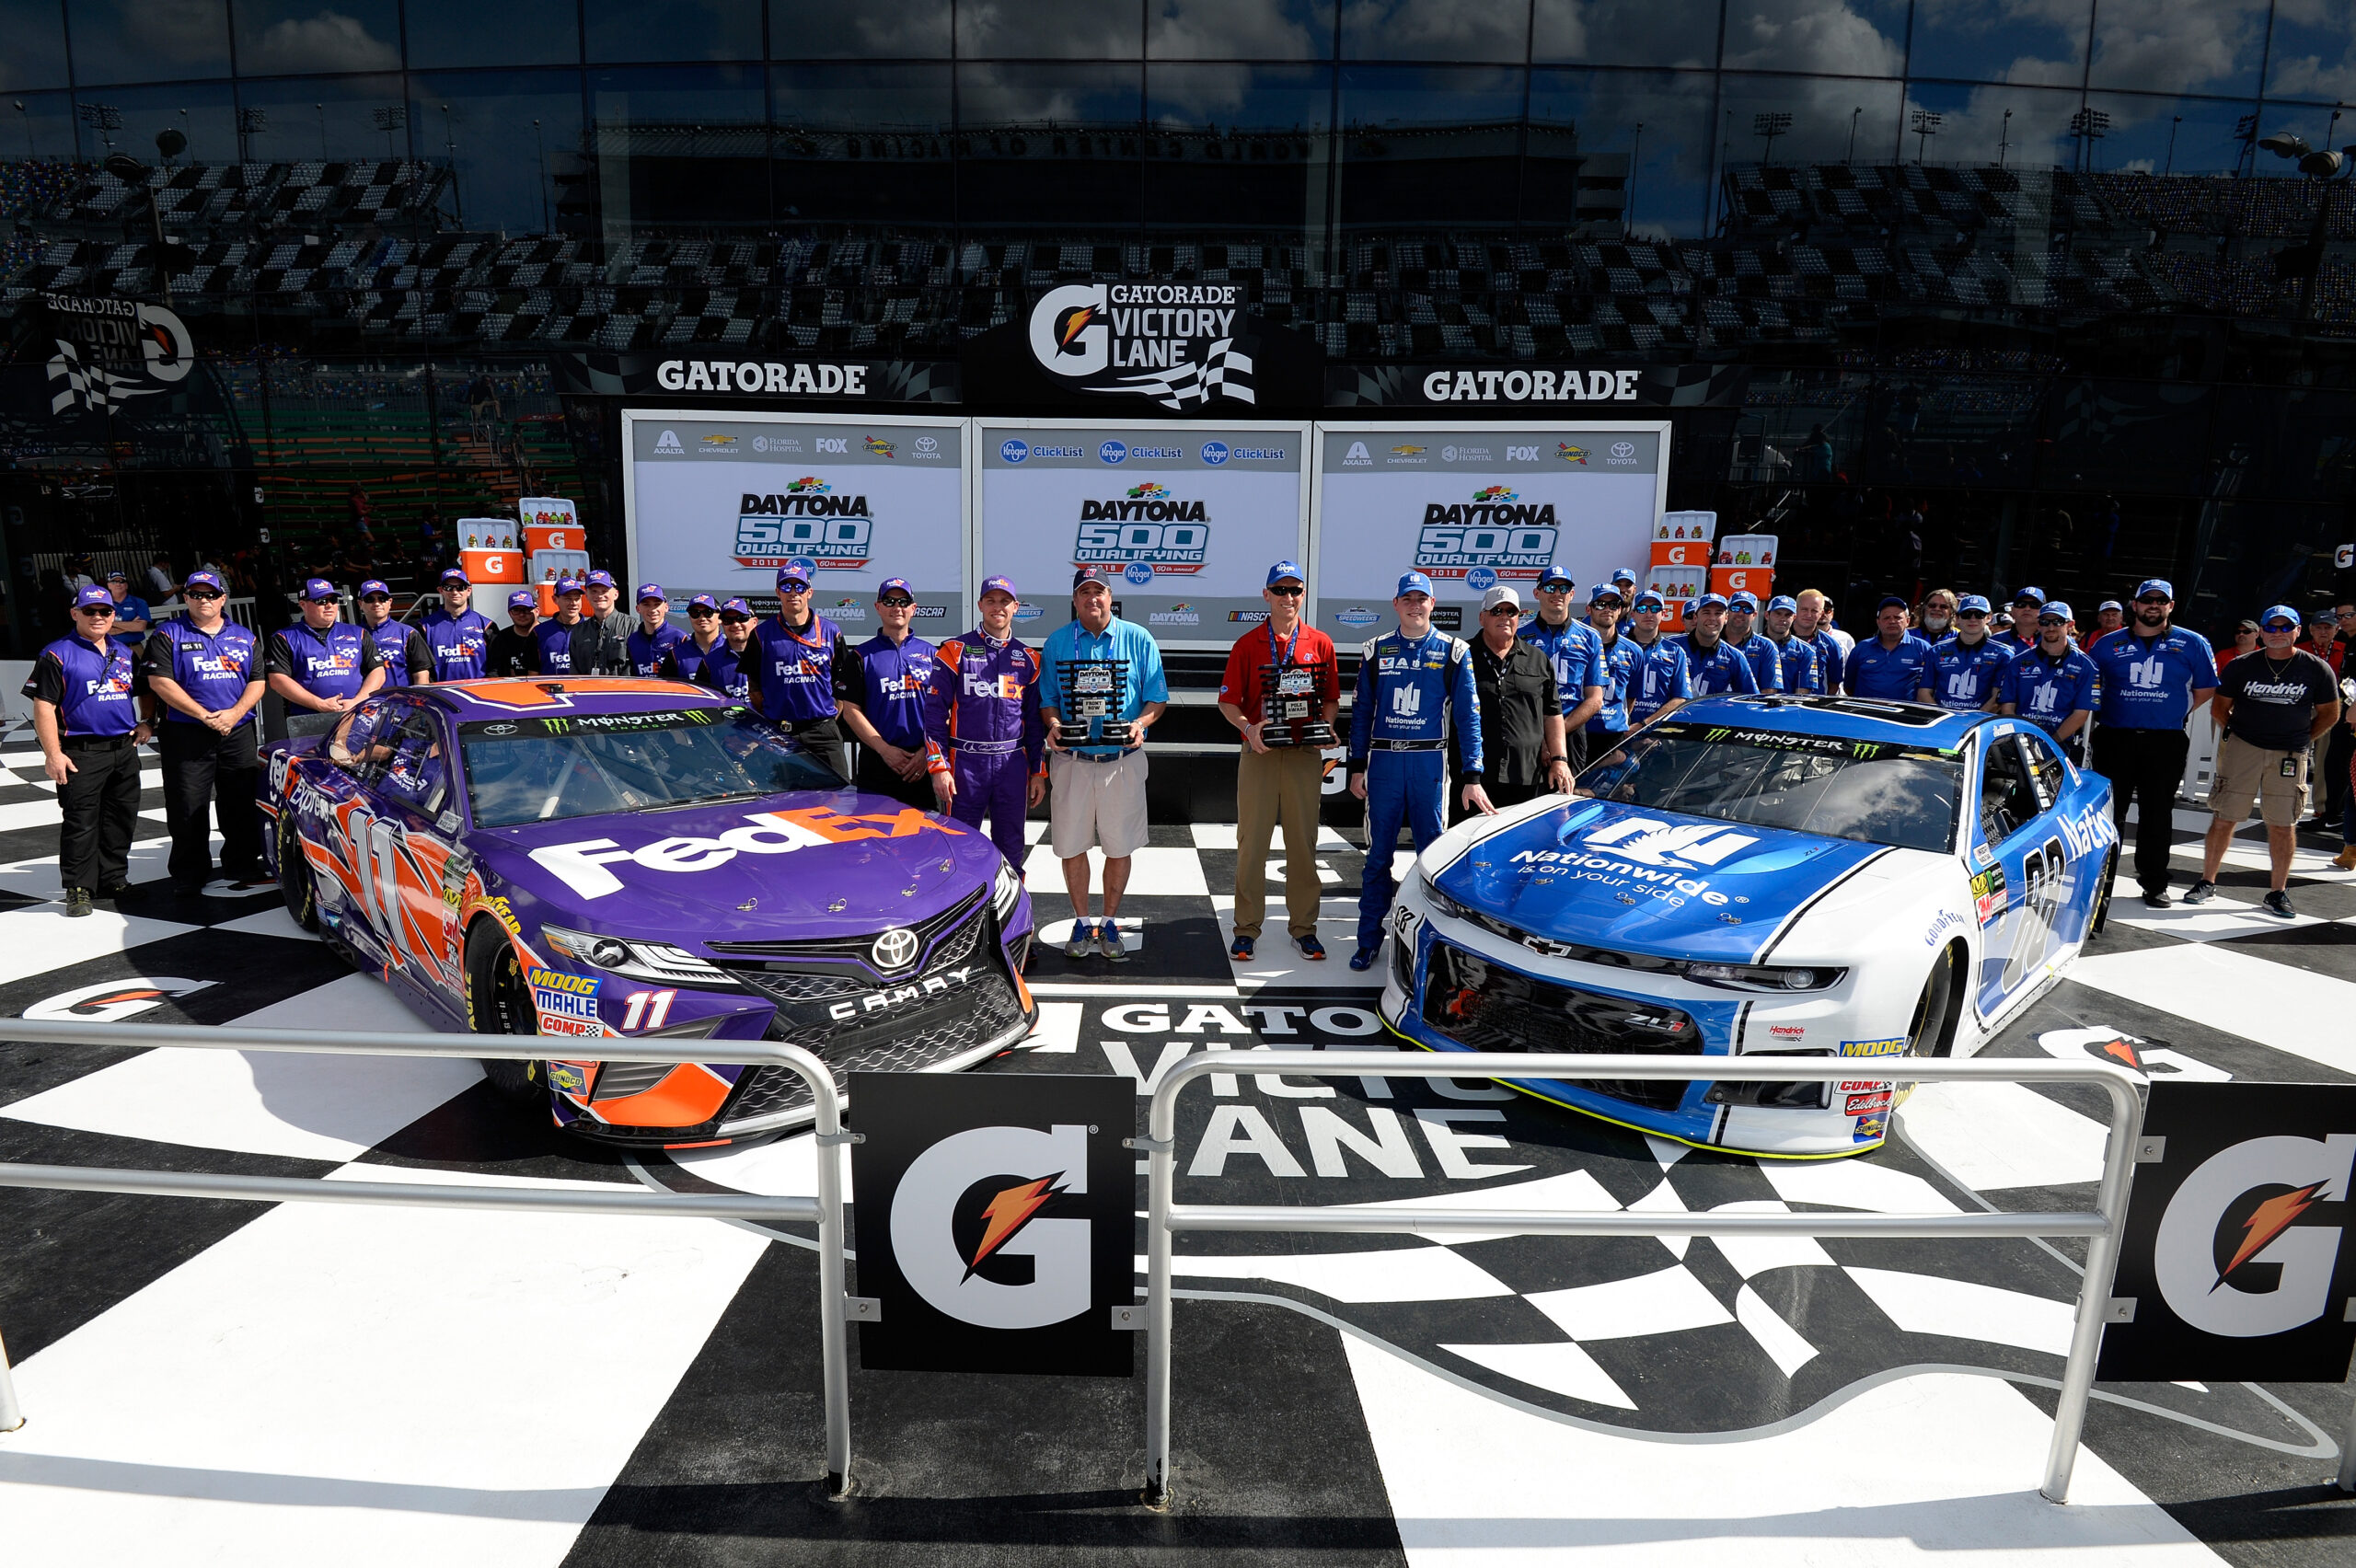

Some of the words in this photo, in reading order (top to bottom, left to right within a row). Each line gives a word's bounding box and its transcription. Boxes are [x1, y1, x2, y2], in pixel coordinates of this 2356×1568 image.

[1111, 285, 1236, 305] GATORADE
[1030, 284, 1108, 376] G
[1111, 307, 1236, 337] VICTORY
[1113, 340, 1187, 367] LANE
[657, 360, 866, 395] GATORADE
[1424, 370, 1639, 400] GATORADE
[769, 444, 803, 453] HOSPITAL
[816, 438, 848, 453] FOX
[1003, 442, 1028, 460] Kroger
[1033, 445, 1084, 457] ClickList
[1100, 444, 1126, 461] Kroger
[1132, 447, 1183, 459] ClickList
[1202, 444, 1228, 462] Kroger
[1233, 448, 1285, 459] ClickList
[1507, 446, 1540, 461] FOX
[1459, 453, 1493, 462] HOSPITAL
[741, 494, 869, 516] DAYTONA
[1080, 501, 1207, 521] DAYTONA
[1424, 503, 1555, 526] DAYTONA
[549, 532, 565, 548] G
[737, 518, 871, 545] 500
[1077, 524, 1208, 550] 500
[1419, 527, 1557, 553] 500
[736, 543, 867, 556] QUALIFYING
[1076, 549, 1204, 561] QUALIFYING
[1669, 547, 1686, 564] G
[485, 557, 502, 573] G
[1415, 554, 1551, 566] QUALIFYING
[1127, 566, 1150, 582] Kroger
[1470, 571, 1495, 588] Kroger
[1729, 572, 1747, 589] G
[913, 607, 945, 617] ASCAR
[1149, 613, 1199, 622] DAYTONA
[437, 644, 479, 657] FedEx
[550, 651, 570, 663] Fed
[192, 655, 242, 672] FedEx
[307, 654, 356, 671] FedEx
[776, 661, 820, 676] FedEx
[202, 672, 238, 680] RACING
[317, 669, 350, 677] RACING
[784, 675, 816, 685] RACING
[87, 678, 132, 696] FedEx
[725, 683, 749, 697] Fed
[880, 674, 922, 694] FedEx
[964, 673, 1026, 699] FedEx
[2244, 681, 2306, 697] Hendrick
[98, 693, 128, 702] RACING
[889, 691, 917, 701] RACING
[2120, 689, 2169, 698] Nationwide
[1941, 699, 1981, 708] Nationwide
[577, 712, 685, 728] MONSTER
[1385, 716, 1426, 725] Nationwide
[1735, 731, 1842, 751] MONSTER
[1754, 742, 1814, 753] ENERGY
[290, 777, 329, 823] Express
[527, 805, 968, 901] FedEx
[347, 805, 415, 964] 11
[1509, 849, 1729, 906] Nationwide
[1518, 864, 1534, 874] is
[1540, 865, 1567, 875] on
[1570, 867, 1631, 887] your
[1632, 882, 1686, 908] side
[530, 969, 600, 995] MOOG
[829, 966, 971, 1020] CAMRY
[537, 990, 596, 1017] MAHLE
[620, 988, 677, 1032] 11
[543, 1017, 586, 1034] COMP
[1624, 1012, 1685, 1032] ZL1
[1770, 1025, 1806, 1035] Hendrick
[1841, 1040, 1903, 1057] MOOG
[549, 1071, 583, 1086] SUNOCO
[1847, 1095, 1891, 1111] Edelbrock
[1856, 1123, 1886, 1134] SUNOCO
[1187, 1105, 1538, 1179] ANE
[890, 1124, 1091, 1329] G
[2154, 1134, 2356, 1338] G
